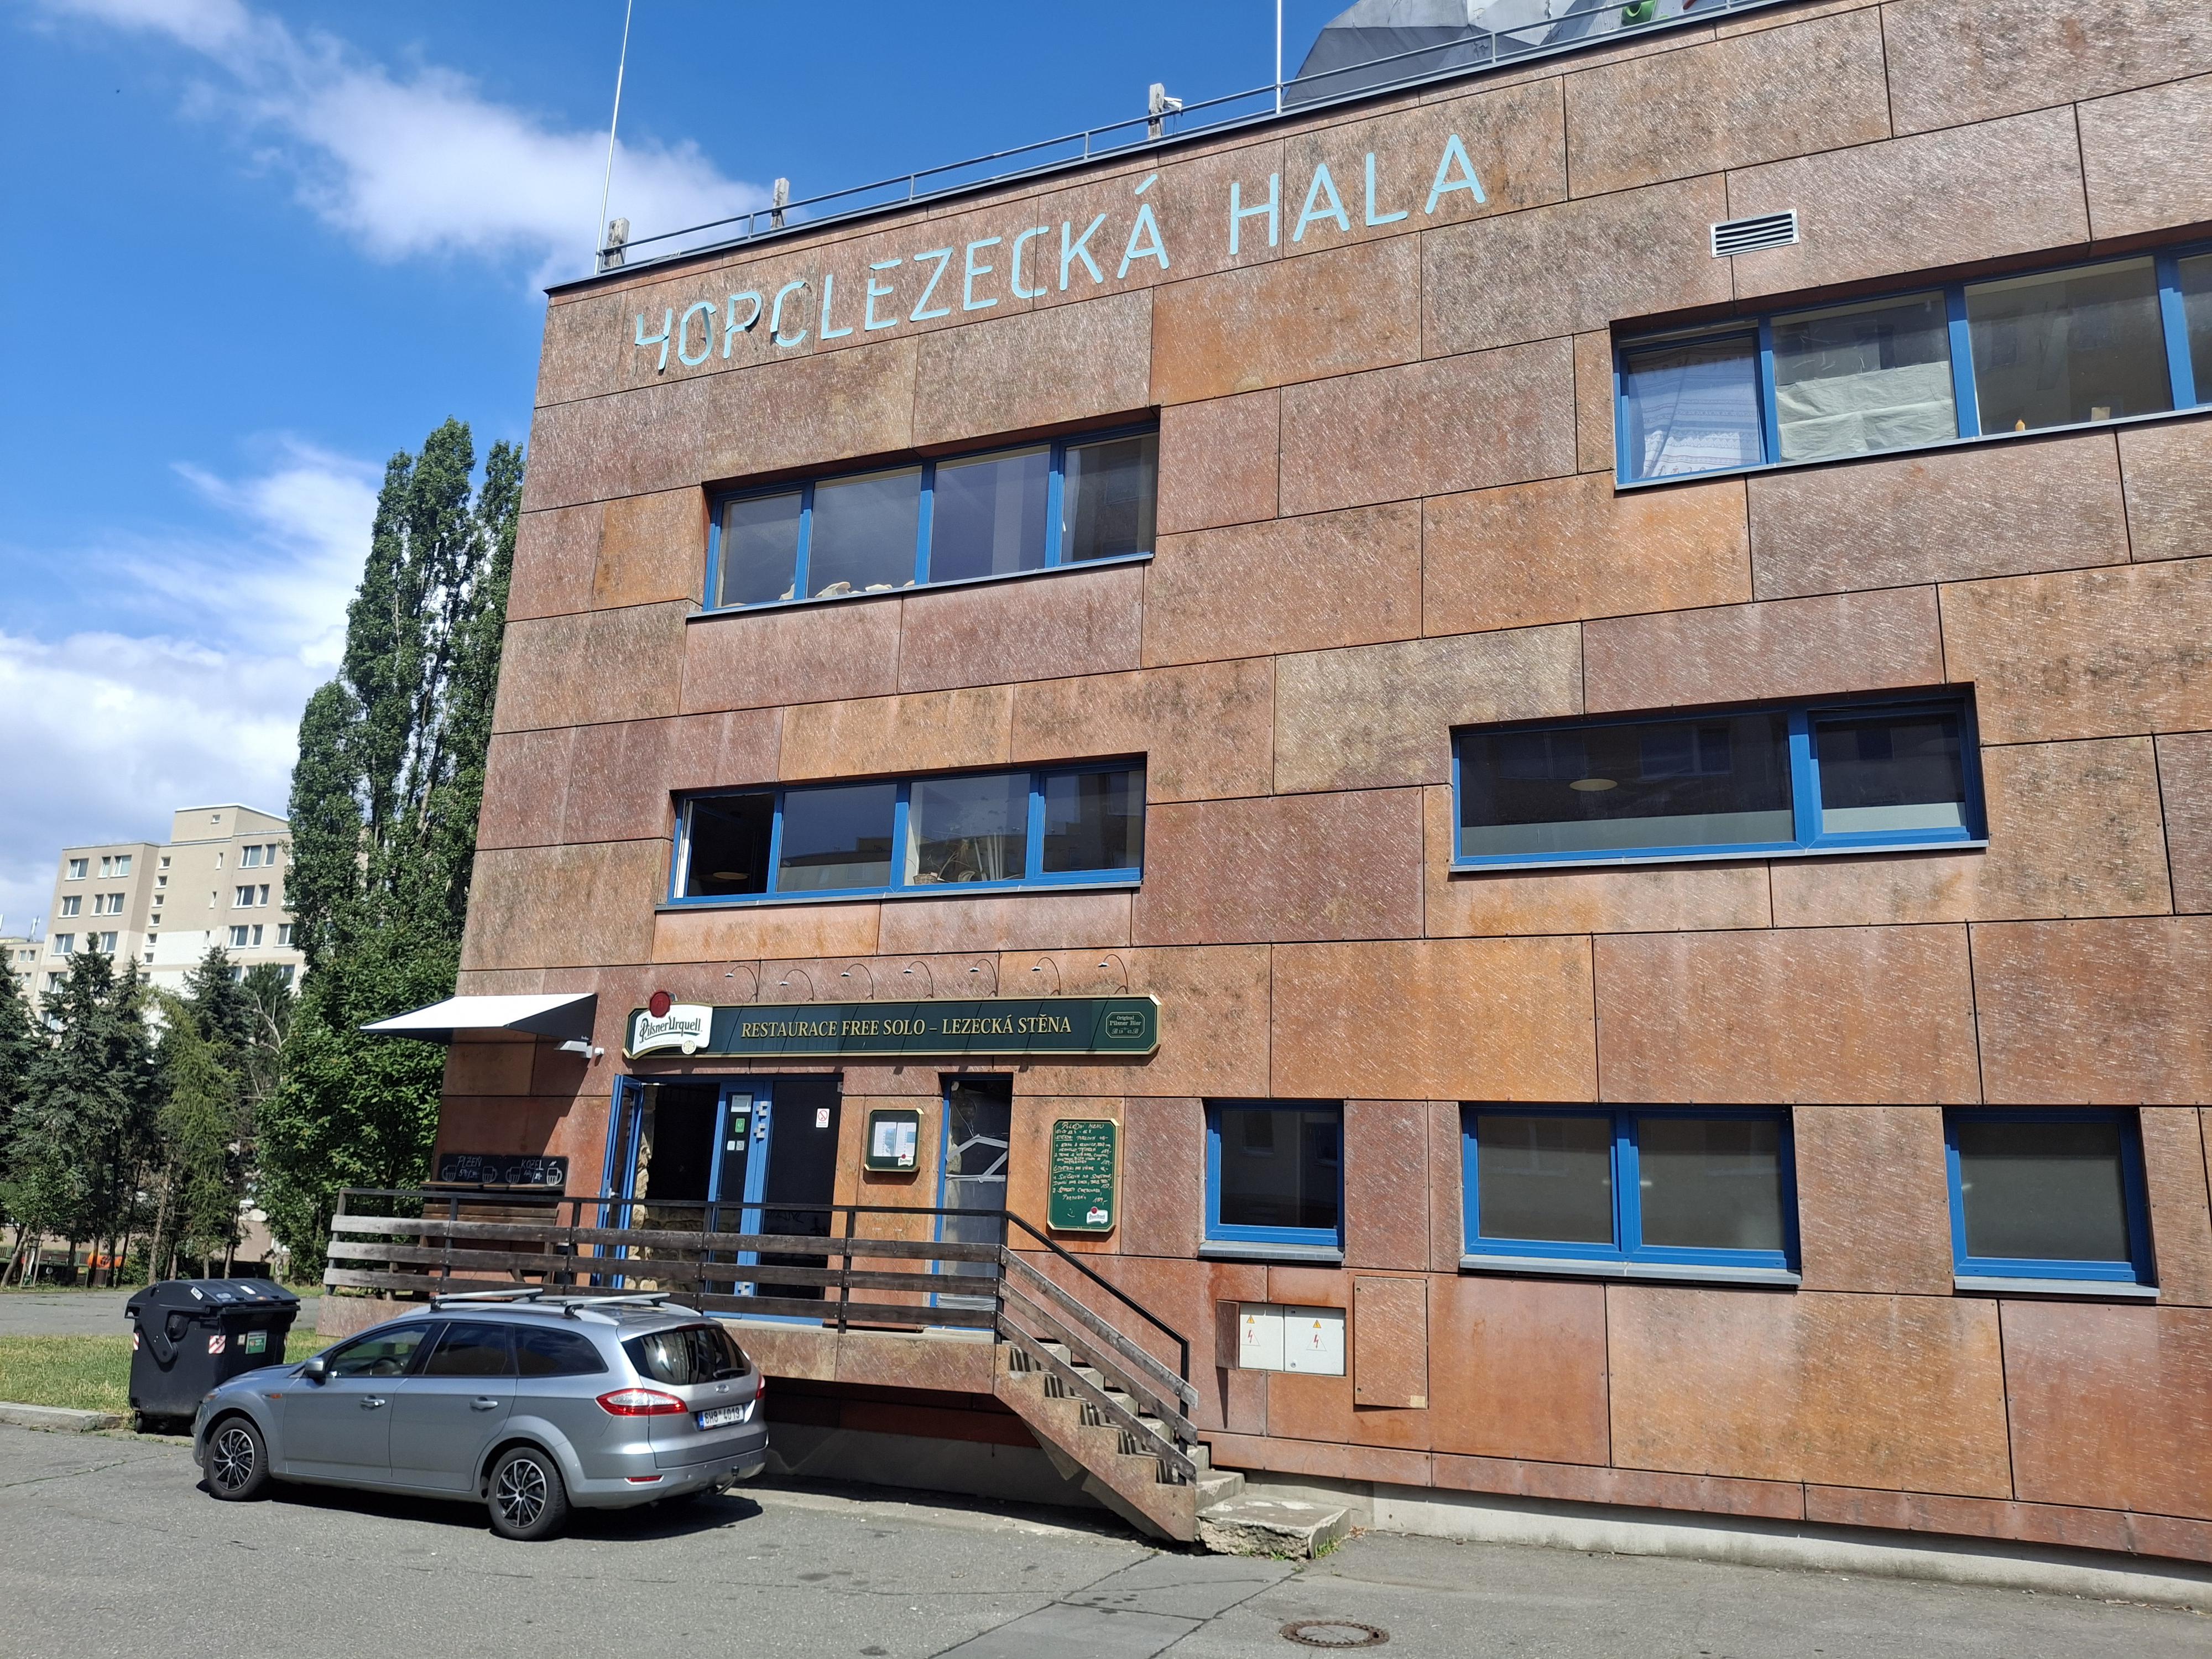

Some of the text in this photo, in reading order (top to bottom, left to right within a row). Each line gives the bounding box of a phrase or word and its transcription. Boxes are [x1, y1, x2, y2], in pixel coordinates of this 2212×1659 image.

[1229, 133, 1486, 255] HALA
[639, 1015, 701, 1044] Pilsner Urquell
[741, 1021, 839, 1039] RESTAURACE
[841, 1020, 880, 1037] FREE
[883, 1019, 926, 1036] SOLO
[942, 1015, 1011, 1035] LEZECKÁ
[1018, 1014, 1072, 1034] STĚNA
[521, 1159, 545, 1171] KOZEL
[723, 1407, 740, 1422] 4019
